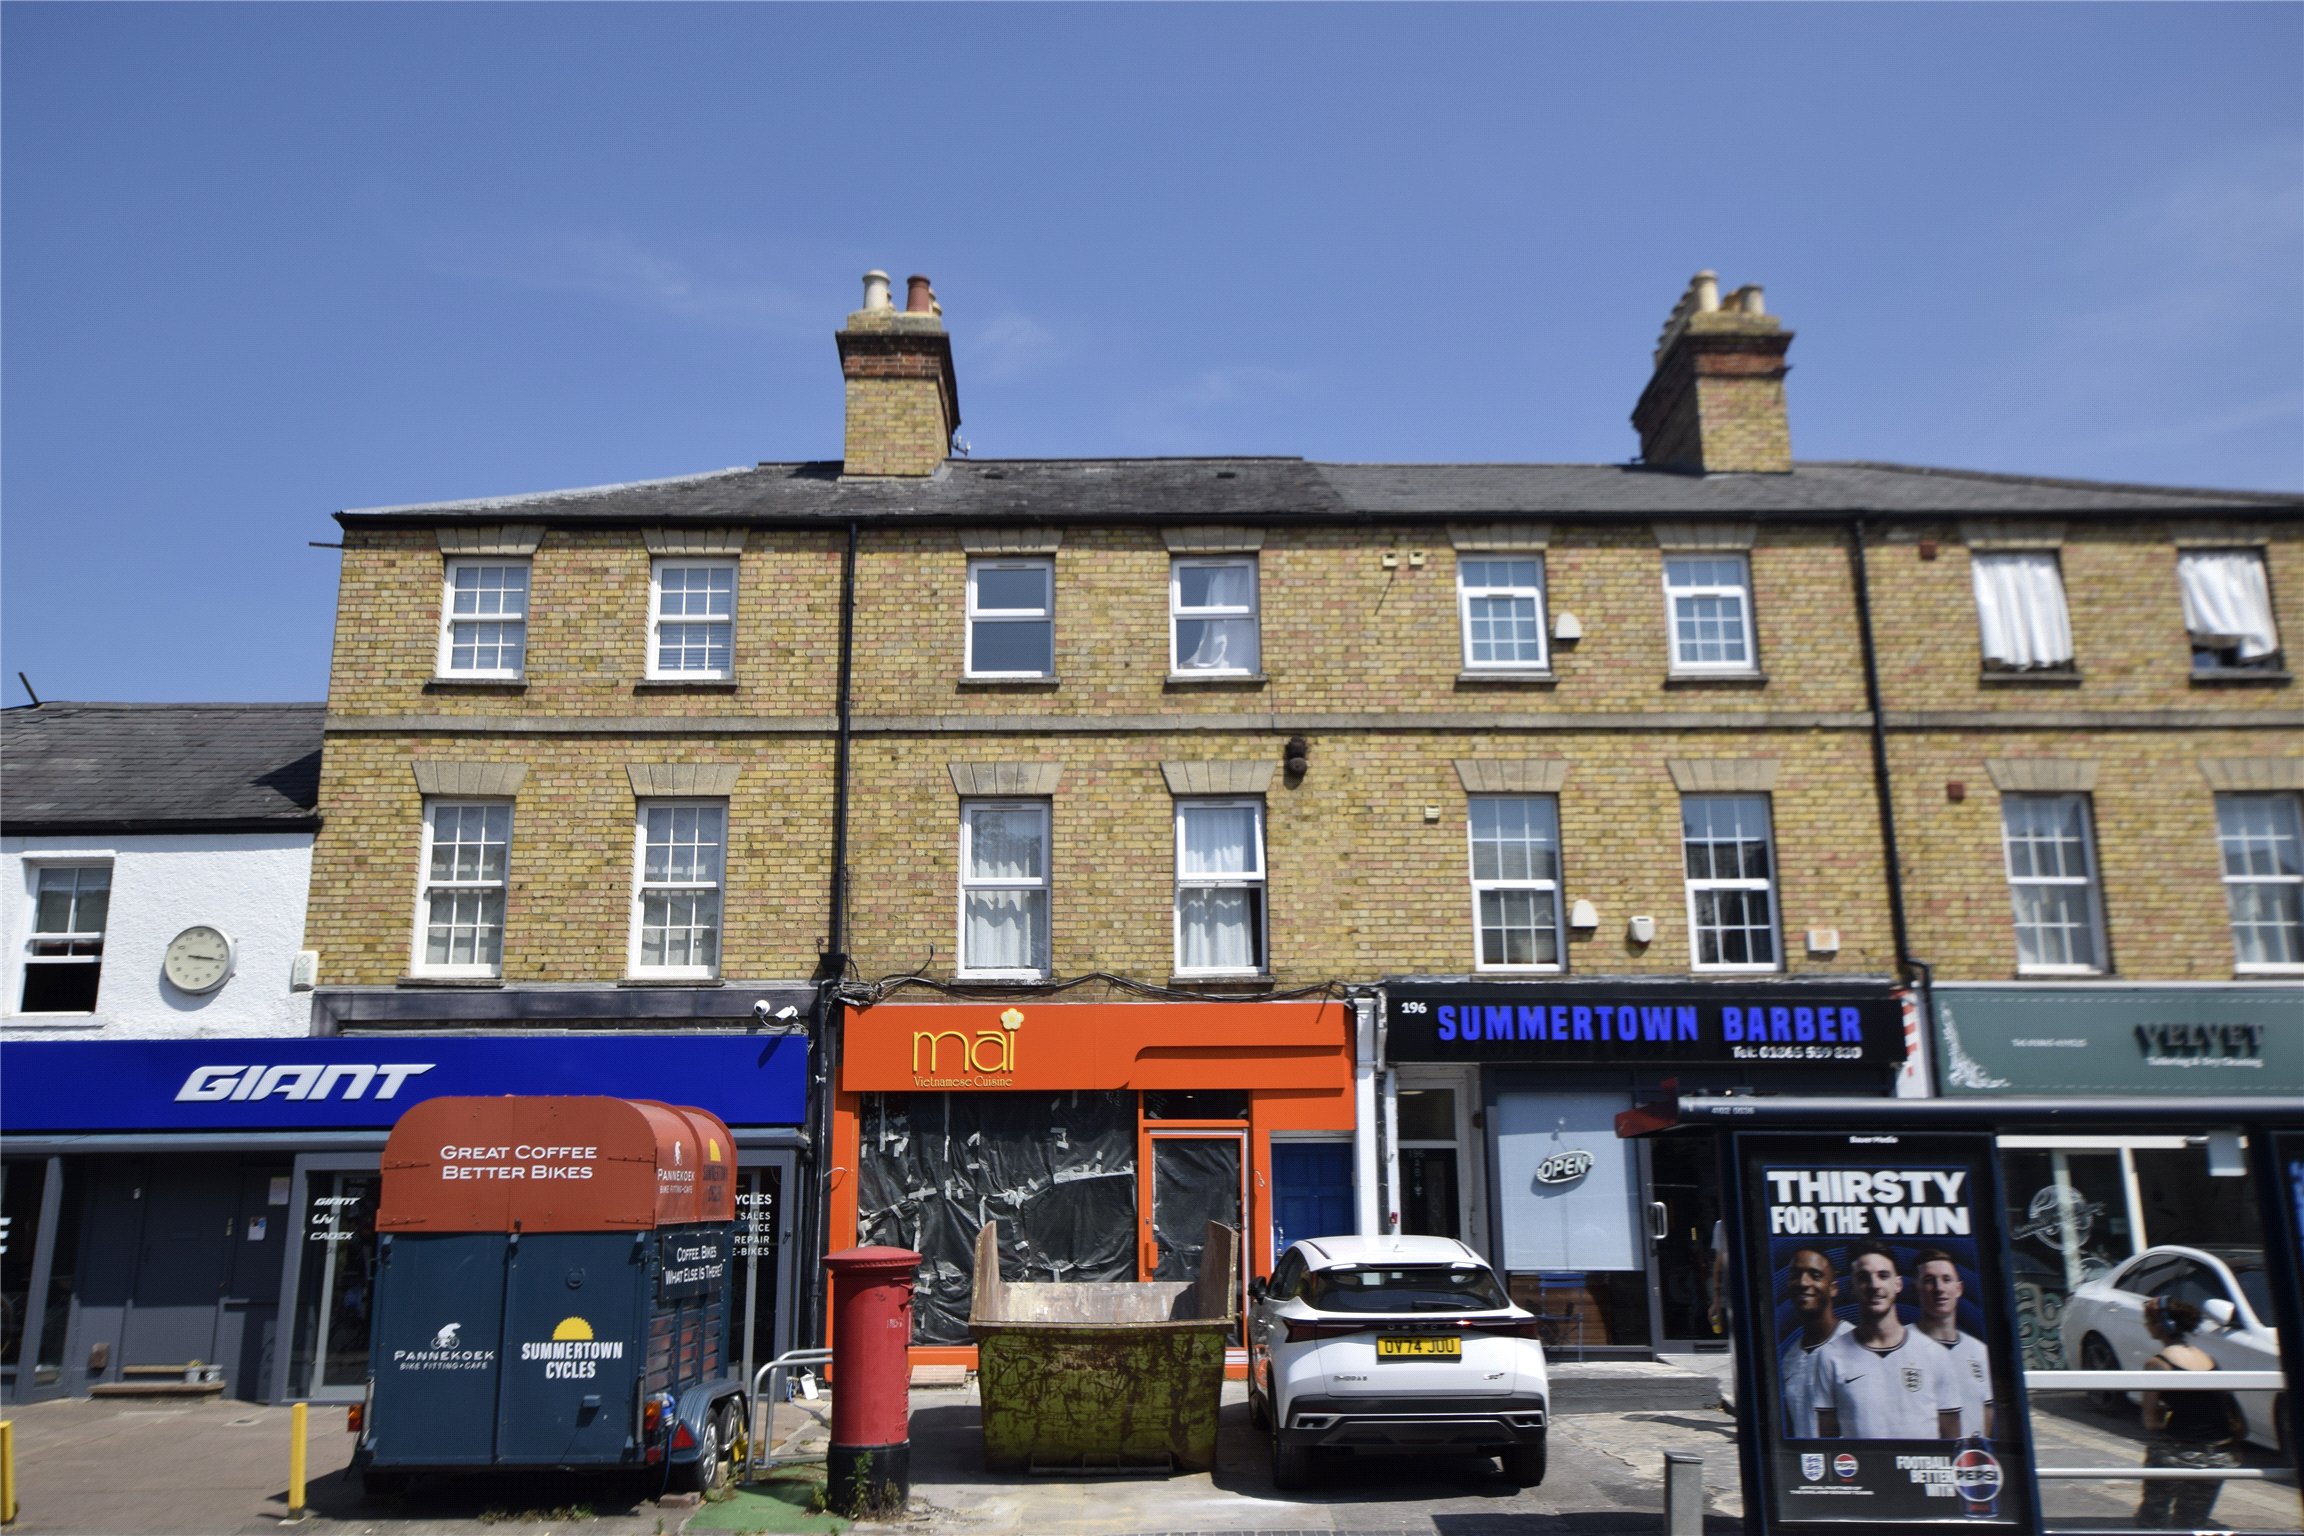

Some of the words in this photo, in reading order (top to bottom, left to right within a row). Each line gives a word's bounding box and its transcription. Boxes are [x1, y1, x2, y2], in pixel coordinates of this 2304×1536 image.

[1401, 1002, 1427, 1014] 196
[1437, 1005, 1699, 1042] SUMMERTOWN
[1721, 1006, 1864, 1043] BARBER
[174, 1063, 437, 1102] GIANT
[913, 1076, 972, 1088] Vietnamese
[973, 1075, 1013, 1088] Cuisine
[440, 1145, 511, 1160] GREAT
[514, 1144, 598, 1160] COFFEE
[442, 1165, 526, 1180] BETTER
[531, 1165, 594, 1180] BIKES
[1540, 1156, 1589, 1179] OPEN
[1766, 1170, 1967, 1204] THIRSTY
[734, 1194, 772, 1206] YCLES
[740, 1212, 771, 1221] SALES
[1770, 1206, 1820, 1234] FOR
[1820, 1206, 1870, 1234] THE
[1874, 1206, 1971, 1235] WIN
[734, 1235, 770, 1244] REPAIR
[393, 1350, 496, 1361] PANNEKOEK
[521, 1341, 624, 1360] SUMMERTOWN
[545, 1360, 597, 1379] CYCLES
[1895, 1455, 1953, 1470] FOOTBALL
[1957, 1469, 1998, 1482] PEPSI
[1924, 1483, 1957, 1497] WITH
